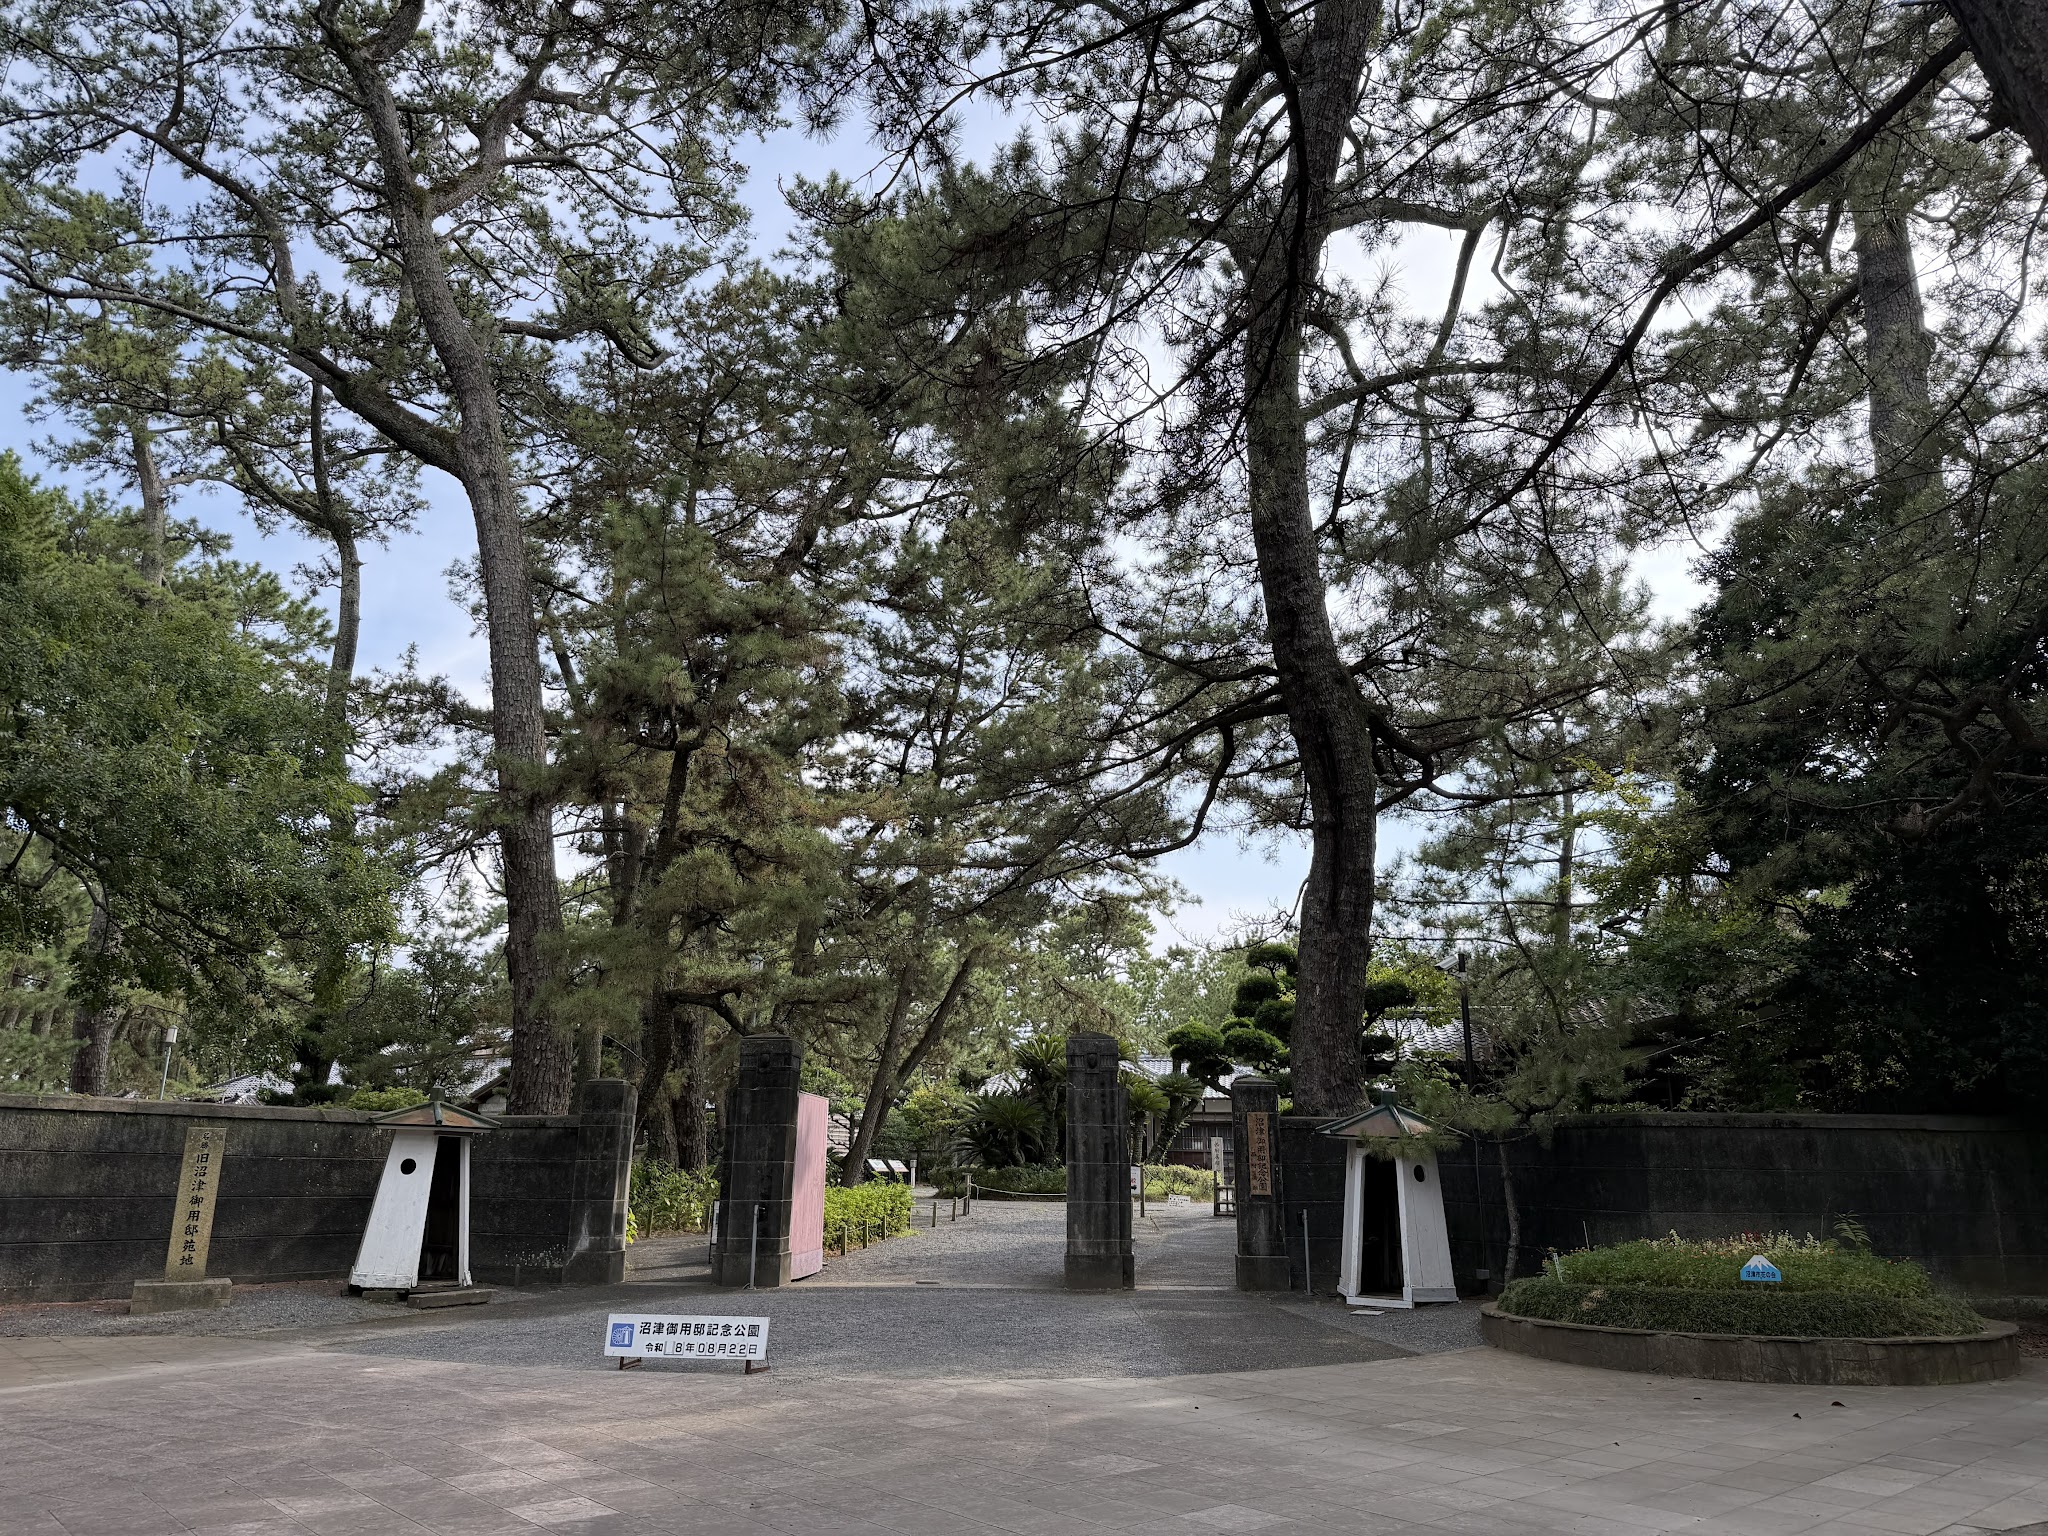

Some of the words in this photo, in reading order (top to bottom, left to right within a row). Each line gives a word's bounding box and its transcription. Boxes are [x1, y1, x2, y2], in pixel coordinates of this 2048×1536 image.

[200, 1132, 211, 1150] 名勝
[179, 1153, 209, 1266] 旧沼津御用邸苑地
[639, 1322, 760, 1337] 沼津御用邸記念公園
